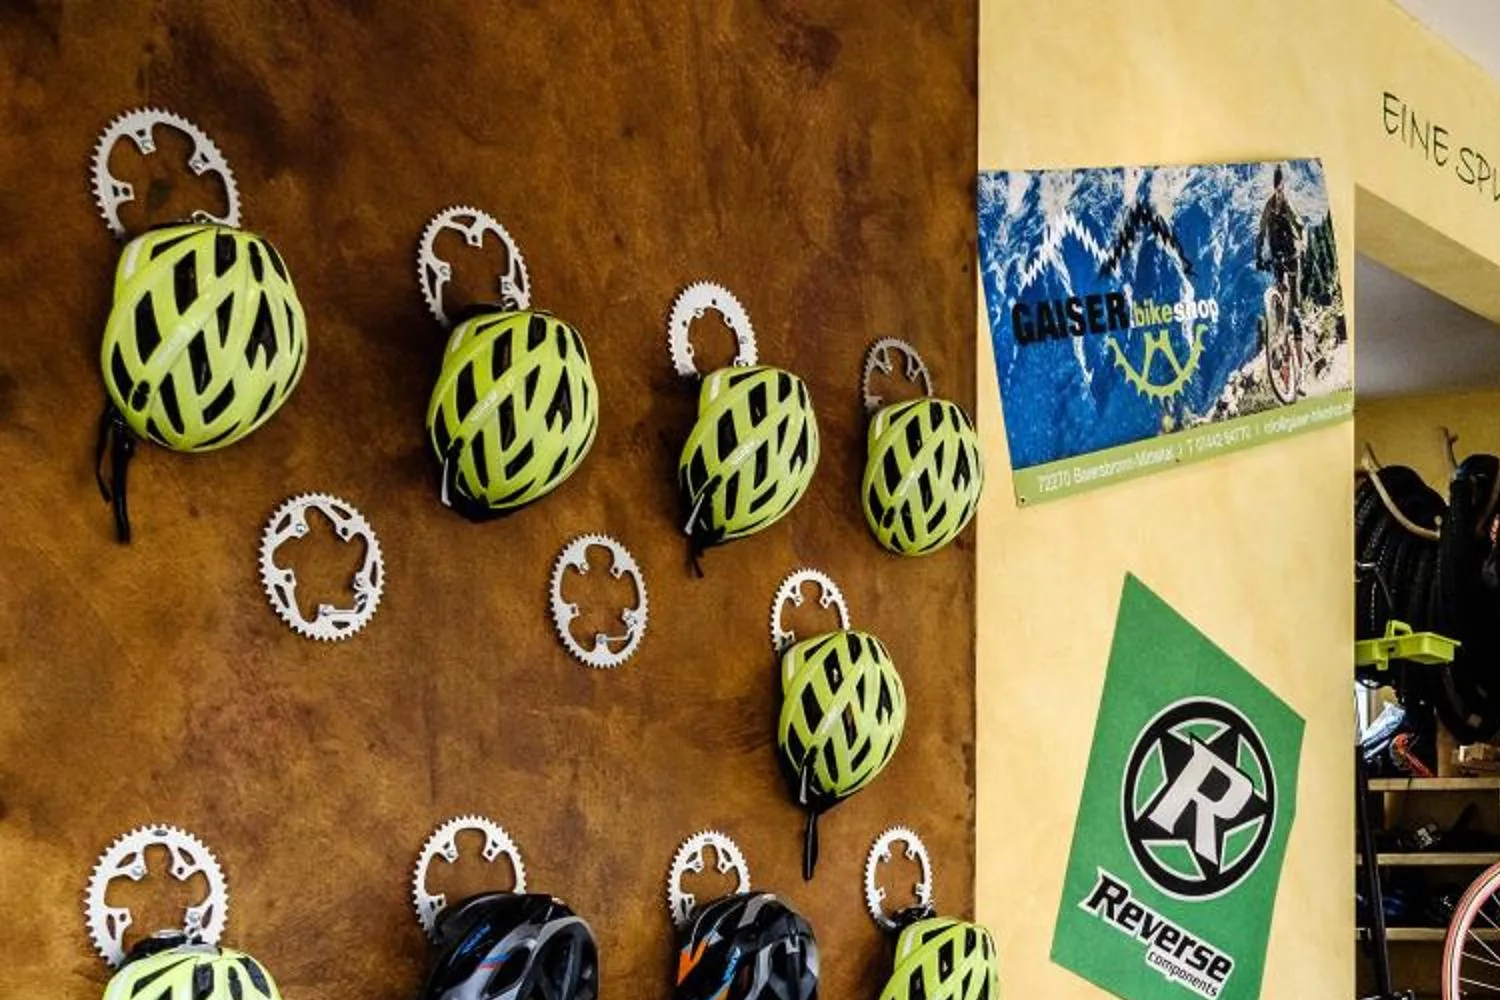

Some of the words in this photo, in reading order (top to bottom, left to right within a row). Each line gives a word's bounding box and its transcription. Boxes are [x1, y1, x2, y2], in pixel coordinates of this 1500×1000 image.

[1382, 91, 1449, 167] EINE
[1012, 292, 1131, 345] GAISER
[1084, 872, 1233, 983] Reverse
[1147, 949, 1219, 997] components
